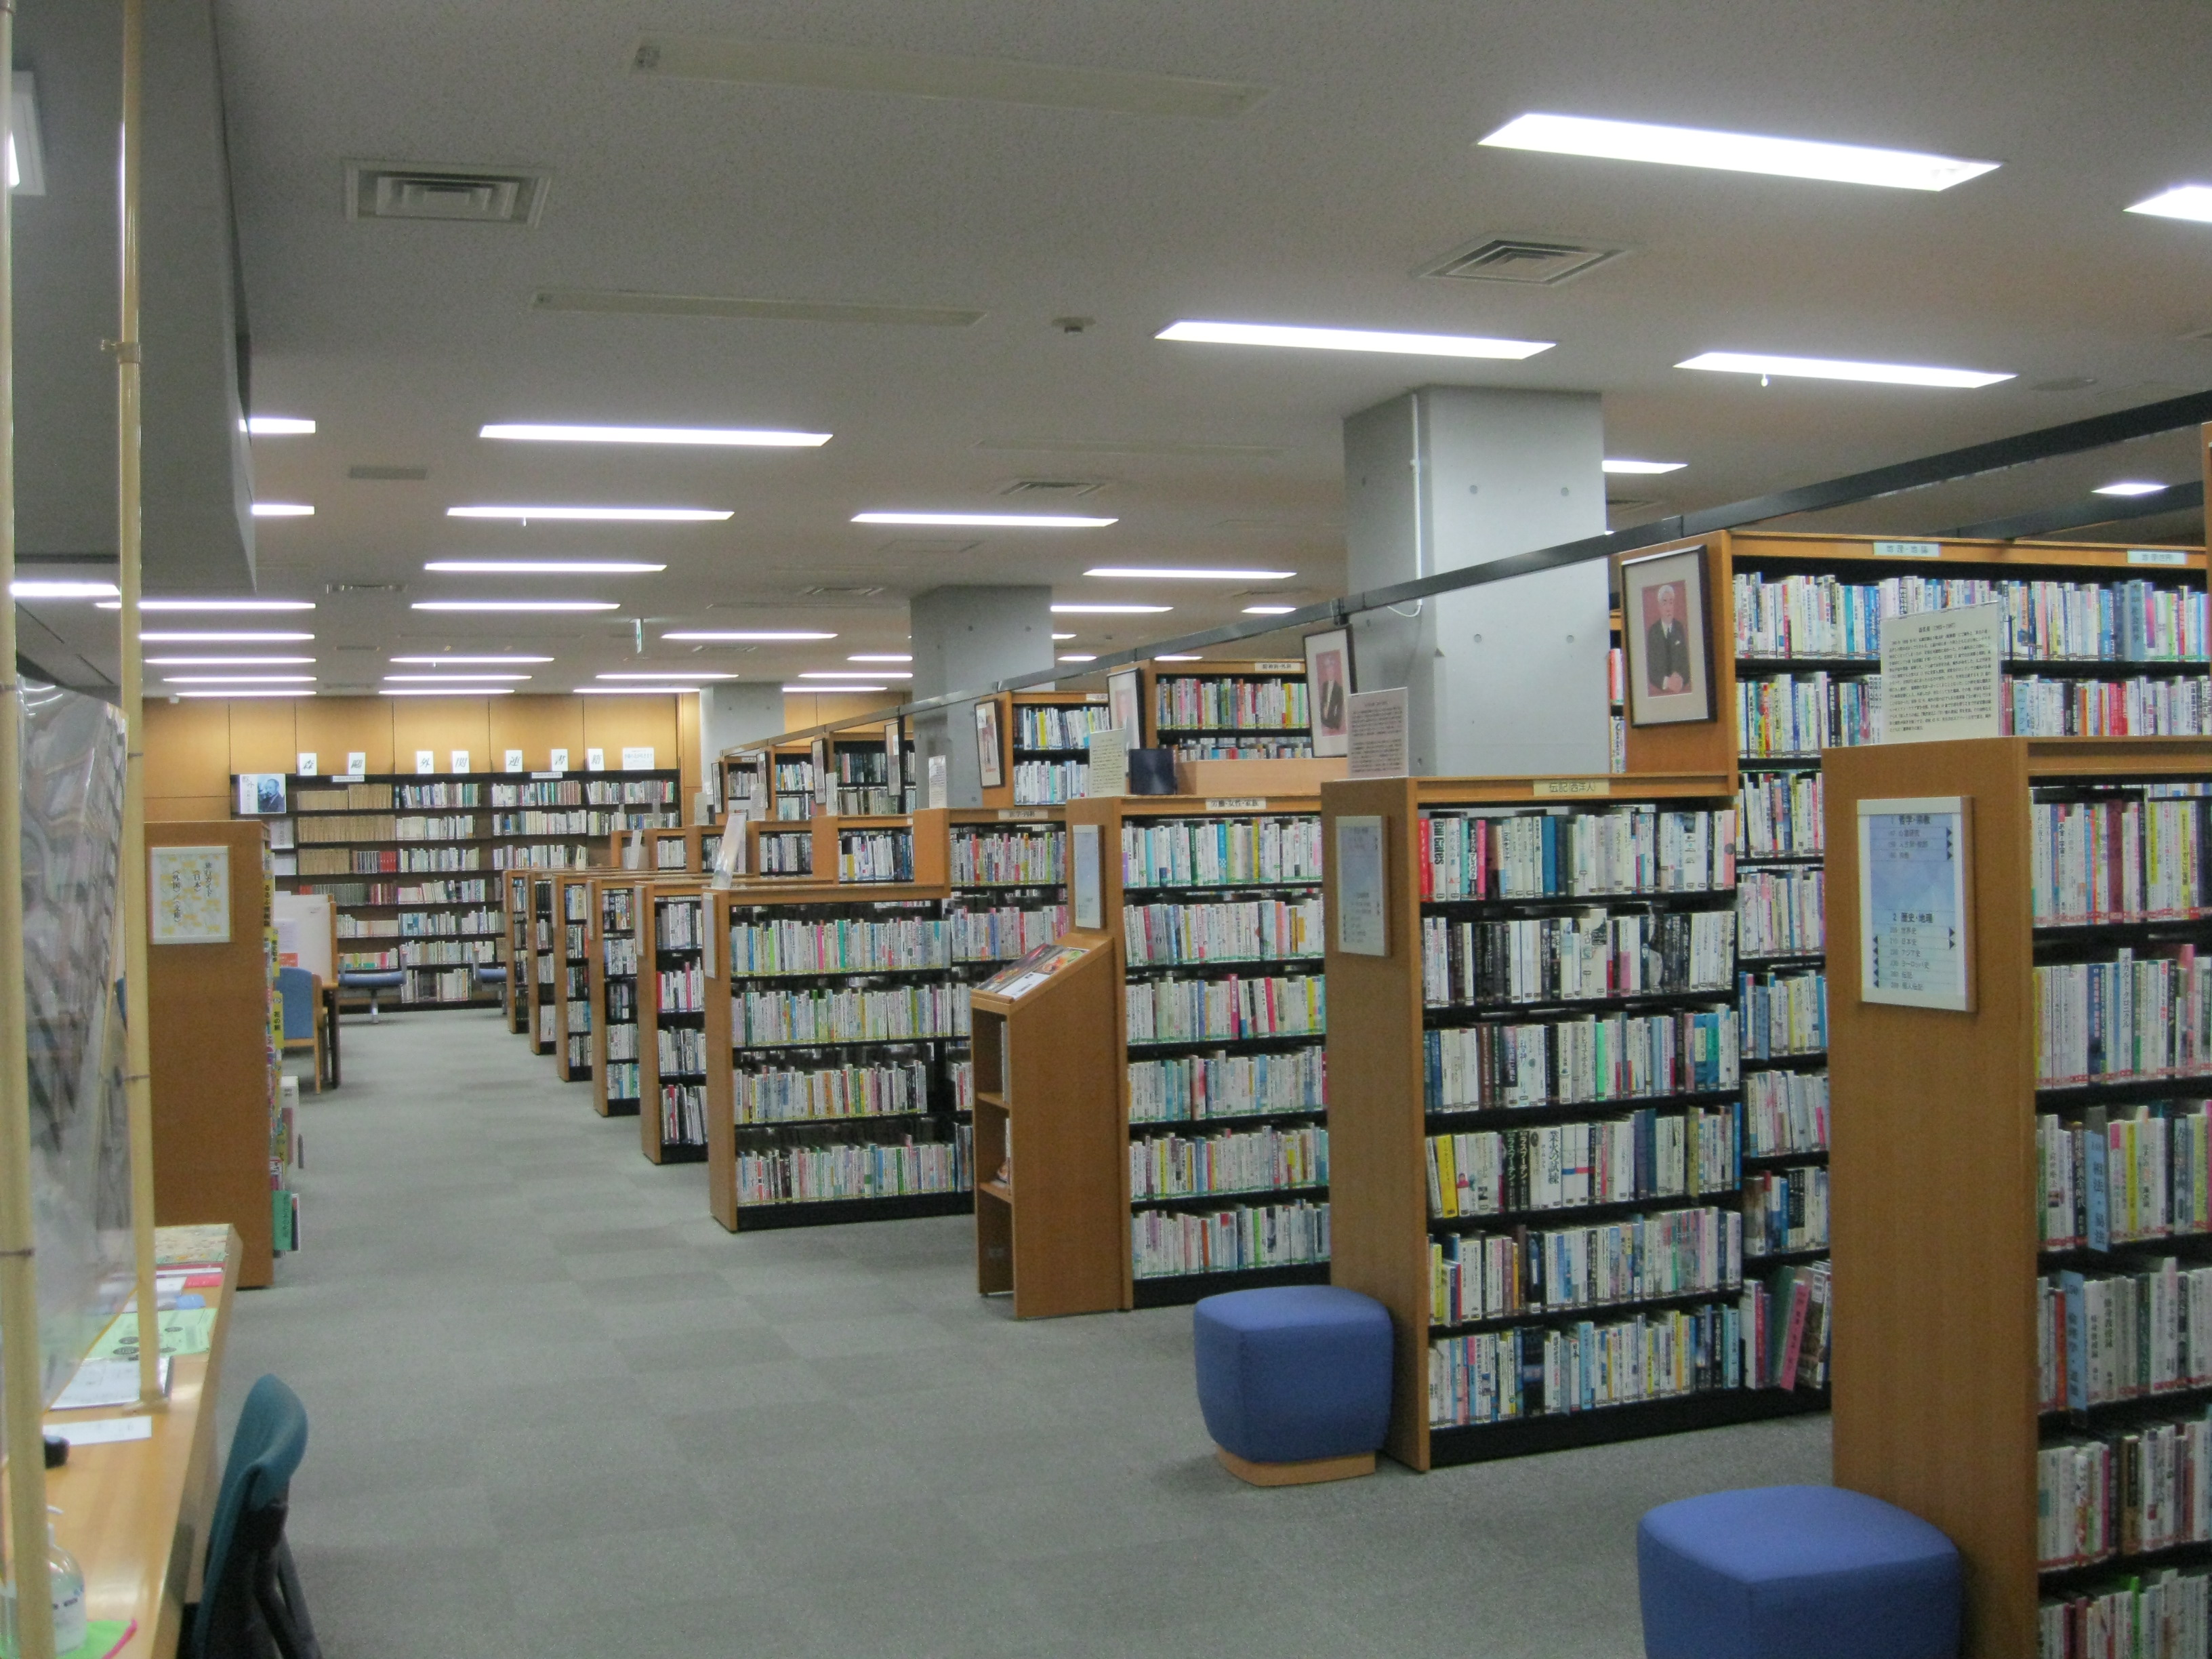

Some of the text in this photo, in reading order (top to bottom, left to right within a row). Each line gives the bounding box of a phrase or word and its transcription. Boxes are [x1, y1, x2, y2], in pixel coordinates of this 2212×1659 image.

[1433, 821, 1444, 865] Bill Gates
[1901, 912, 1933, 923] 歴史・地理
[1901, 926, 1917, 935] 世界史
[1902, 937, 1917, 945] 日本史
[1902, 949, 1921, 957] アジア史
[1902, 960, 1929, 969] ヨーロッパ史
[1519, 1136, 1528, 1180] ラスプーチン
